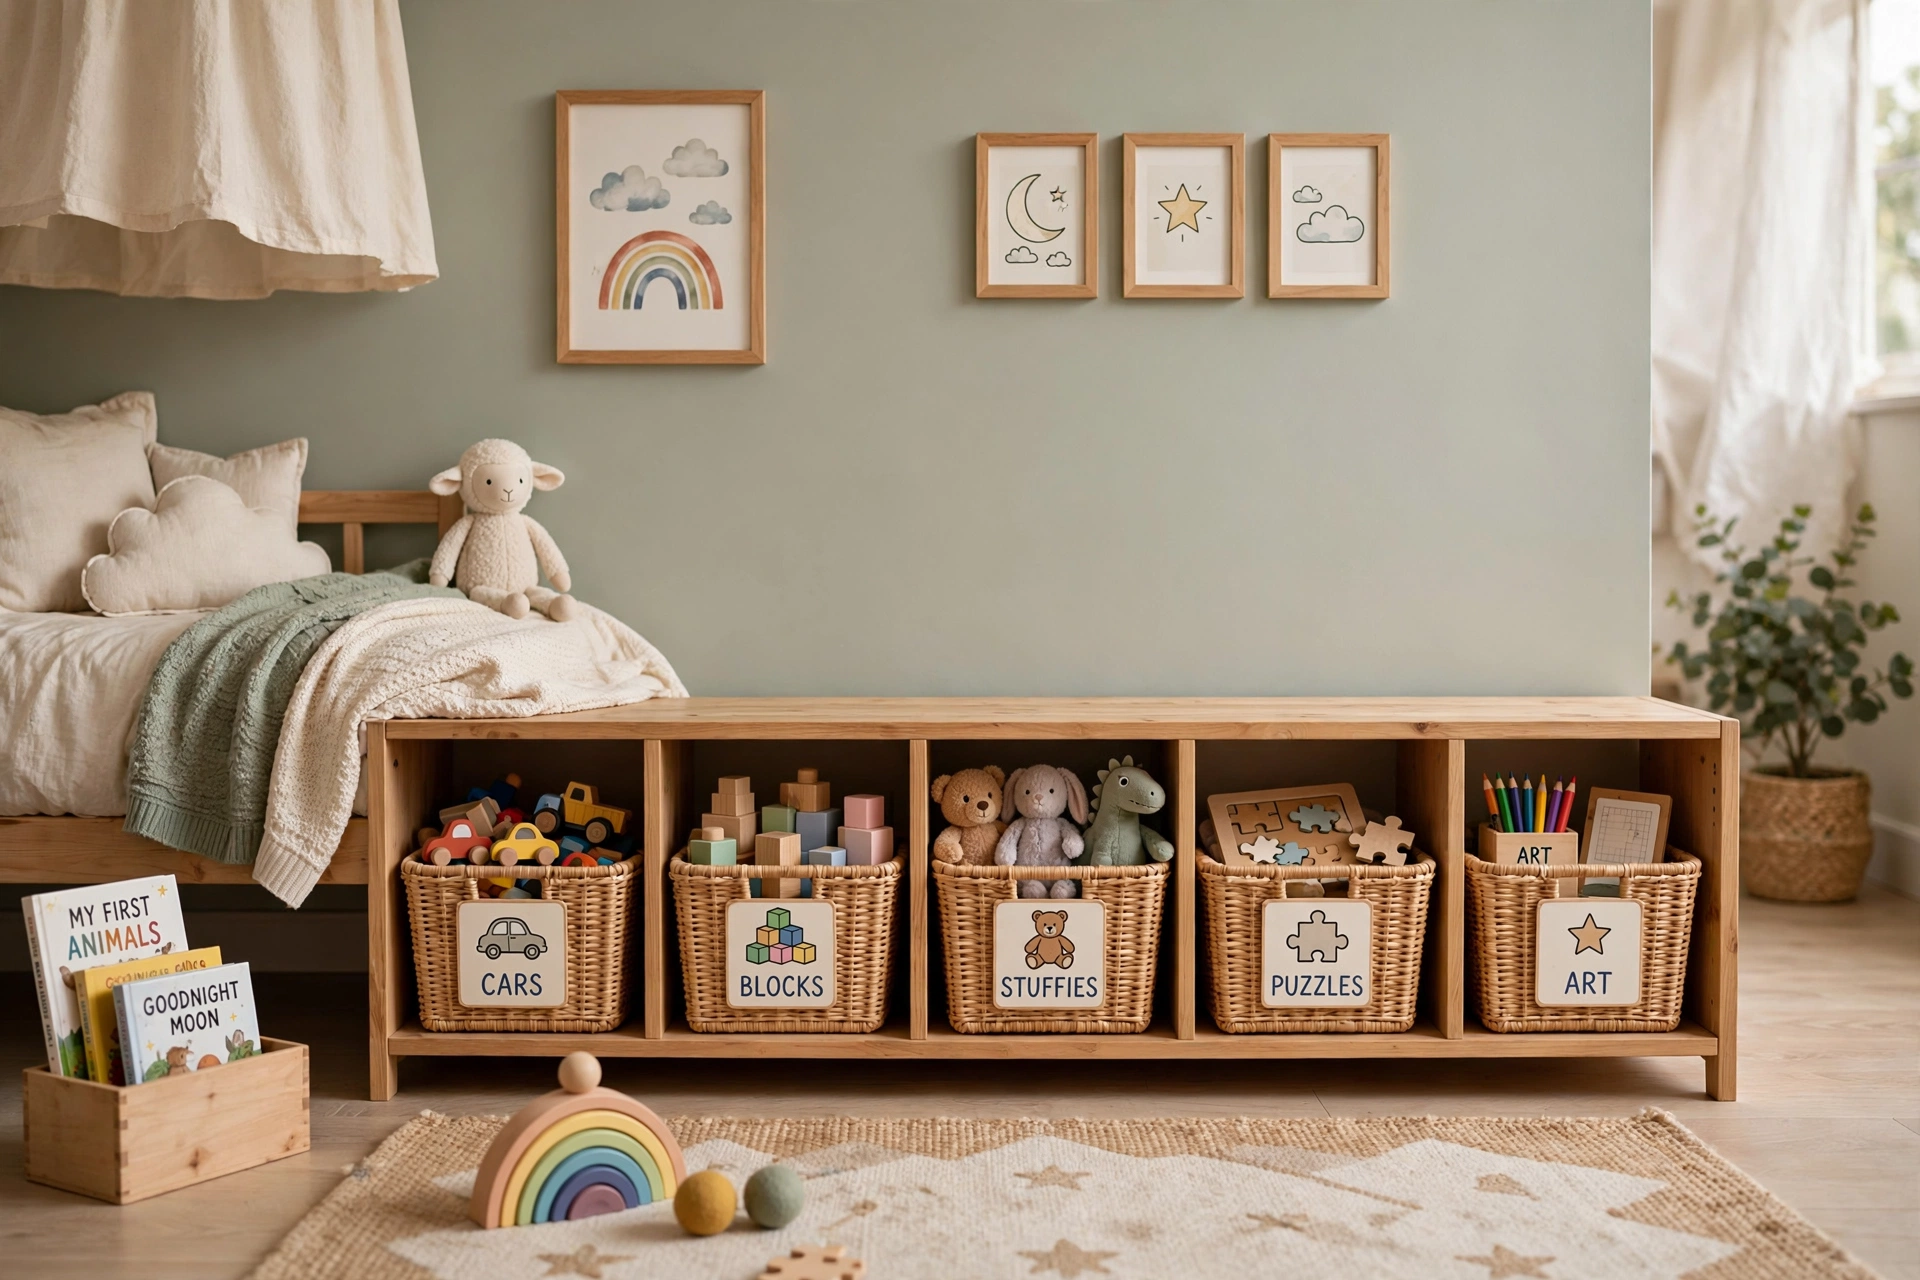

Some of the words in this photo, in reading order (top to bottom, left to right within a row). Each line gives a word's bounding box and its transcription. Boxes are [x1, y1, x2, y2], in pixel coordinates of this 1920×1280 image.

[1516, 846, 1553, 865] ART
[68, 904, 95, 929] MY
[102, 895, 150, 923] FIRST
[68, 920, 161, 961] ANIMALS
[481, 972, 543, 997] CARS
[740, 975, 824, 998] BLOCKS
[1000, 976, 1098, 998] STUFFIES
[1271, 974, 1363, 997] PUZZLES
[1564, 971, 1613, 995] ART
[143, 980, 239, 1017] GOODNIGHT
[170, 1007, 220, 1036] MOON
